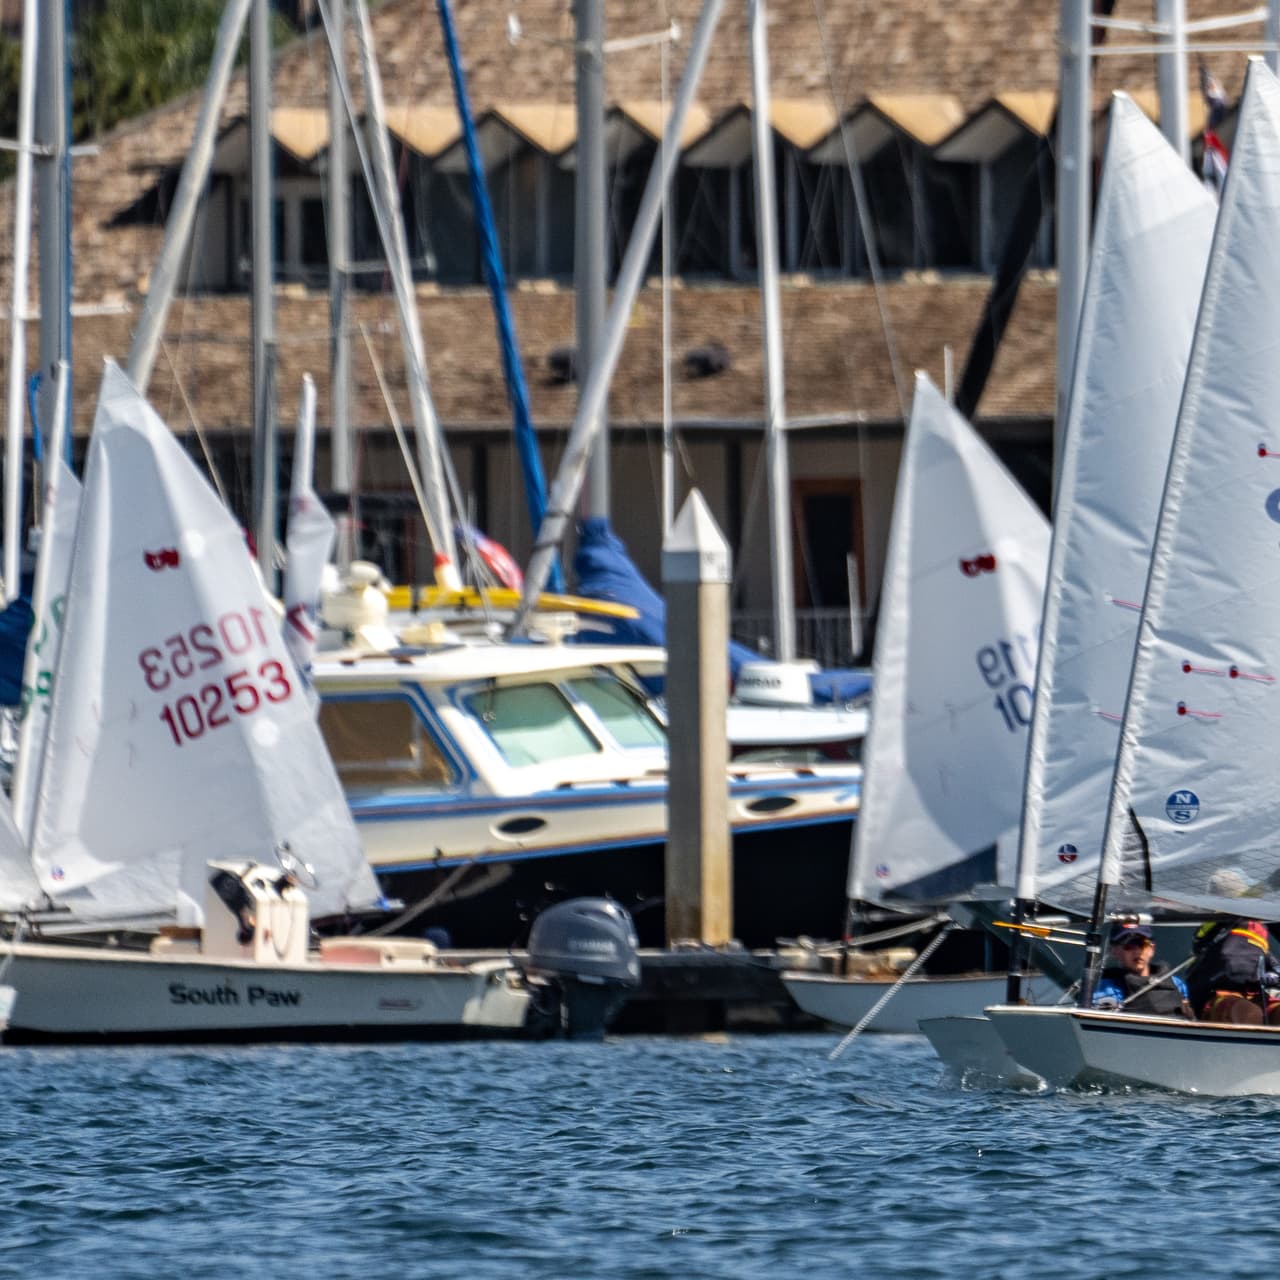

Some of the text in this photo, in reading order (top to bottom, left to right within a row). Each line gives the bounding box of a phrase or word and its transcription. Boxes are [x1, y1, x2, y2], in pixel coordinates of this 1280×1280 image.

[160, 660, 291, 747] 10253
[168, 983, 301, 1007] South Paw
